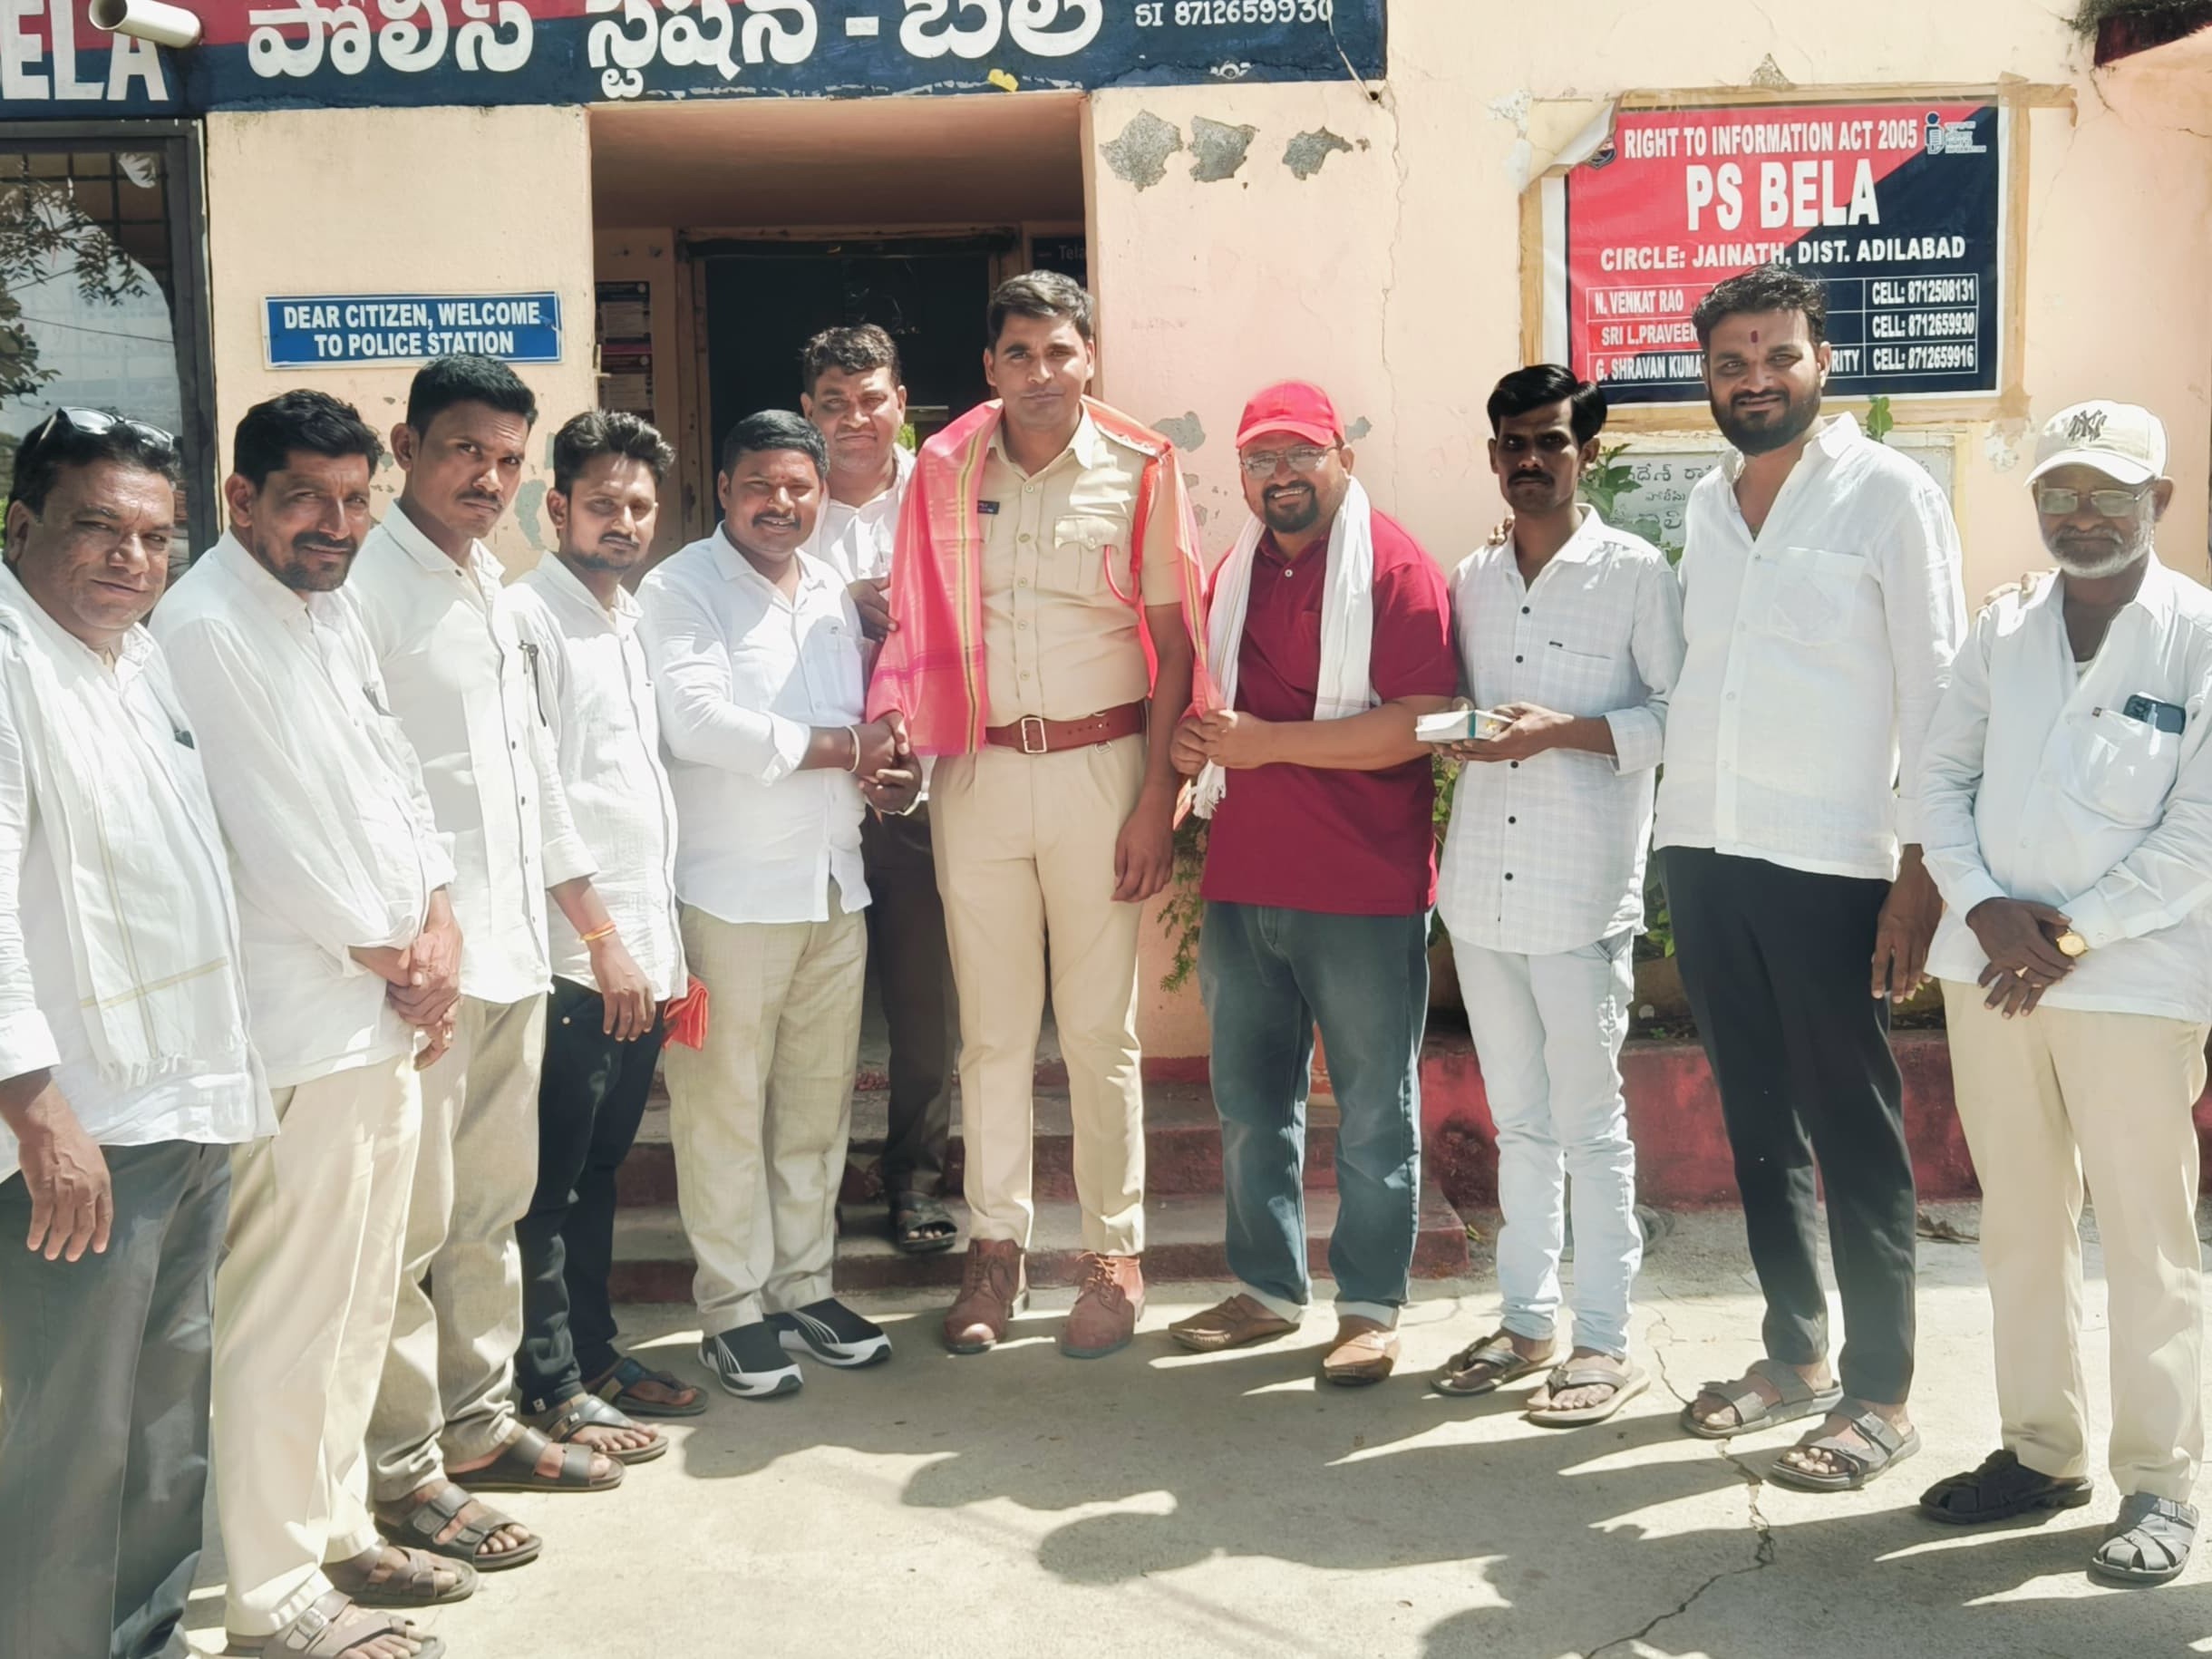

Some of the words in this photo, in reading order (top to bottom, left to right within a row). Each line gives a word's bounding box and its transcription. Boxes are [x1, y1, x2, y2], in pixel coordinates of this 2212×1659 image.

[1134, 2, 1164, 26] SI
[1174, 0, 1334, 26] 8712659930
[0, 0, 170, 102] ELA
[1624, 127, 1679, 159] RIGHT
[1683, 126, 1707, 157] TO
[1712, 121, 1834, 156] INFORMATION
[1838, 121, 1874, 151] ACT
[1877, 119, 1918, 150] 2005
[1686, 161, 1743, 231] PS
[1761, 158, 1880, 228] BELA
[1601, 245, 1686, 271] CIRCLE:
[1692, 241, 1792, 268] JAINATH,
[1798, 239, 1850, 264] DIST.
[1856, 236, 1966, 262] ADILABAD
[1595, 292, 1607, 314] N.
[1610, 290, 1656, 314] VENKAT
[1659, 289, 1684, 312] RAO
[1872, 281, 1906, 305] CELL:
[1907, 277, 1975, 304] 8712508131
[283, 305, 340, 329] DEAR
[345, 302, 433, 331] CITIZEN,
[438, 301, 541, 325] WELCOME
[1872, 315, 1906, 338] CELL:
[1907, 312, 1975, 336] 8712659930
[314, 334, 343, 356] TO
[348, 331, 422, 356] POLICE
[428, 330, 514, 354] STATION
[1601, 324, 1624, 346] SRI
[1596, 357, 1608, 381] G.
[1611, 355, 1664, 381] SHRAVAN
[1668, 353, 1705, 378] KUMA
[1830, 349, 1860, 373] RITY
[1873, 347, 1906, 371] CELL:
[1907, 344, 1975, 370] 8712659916
